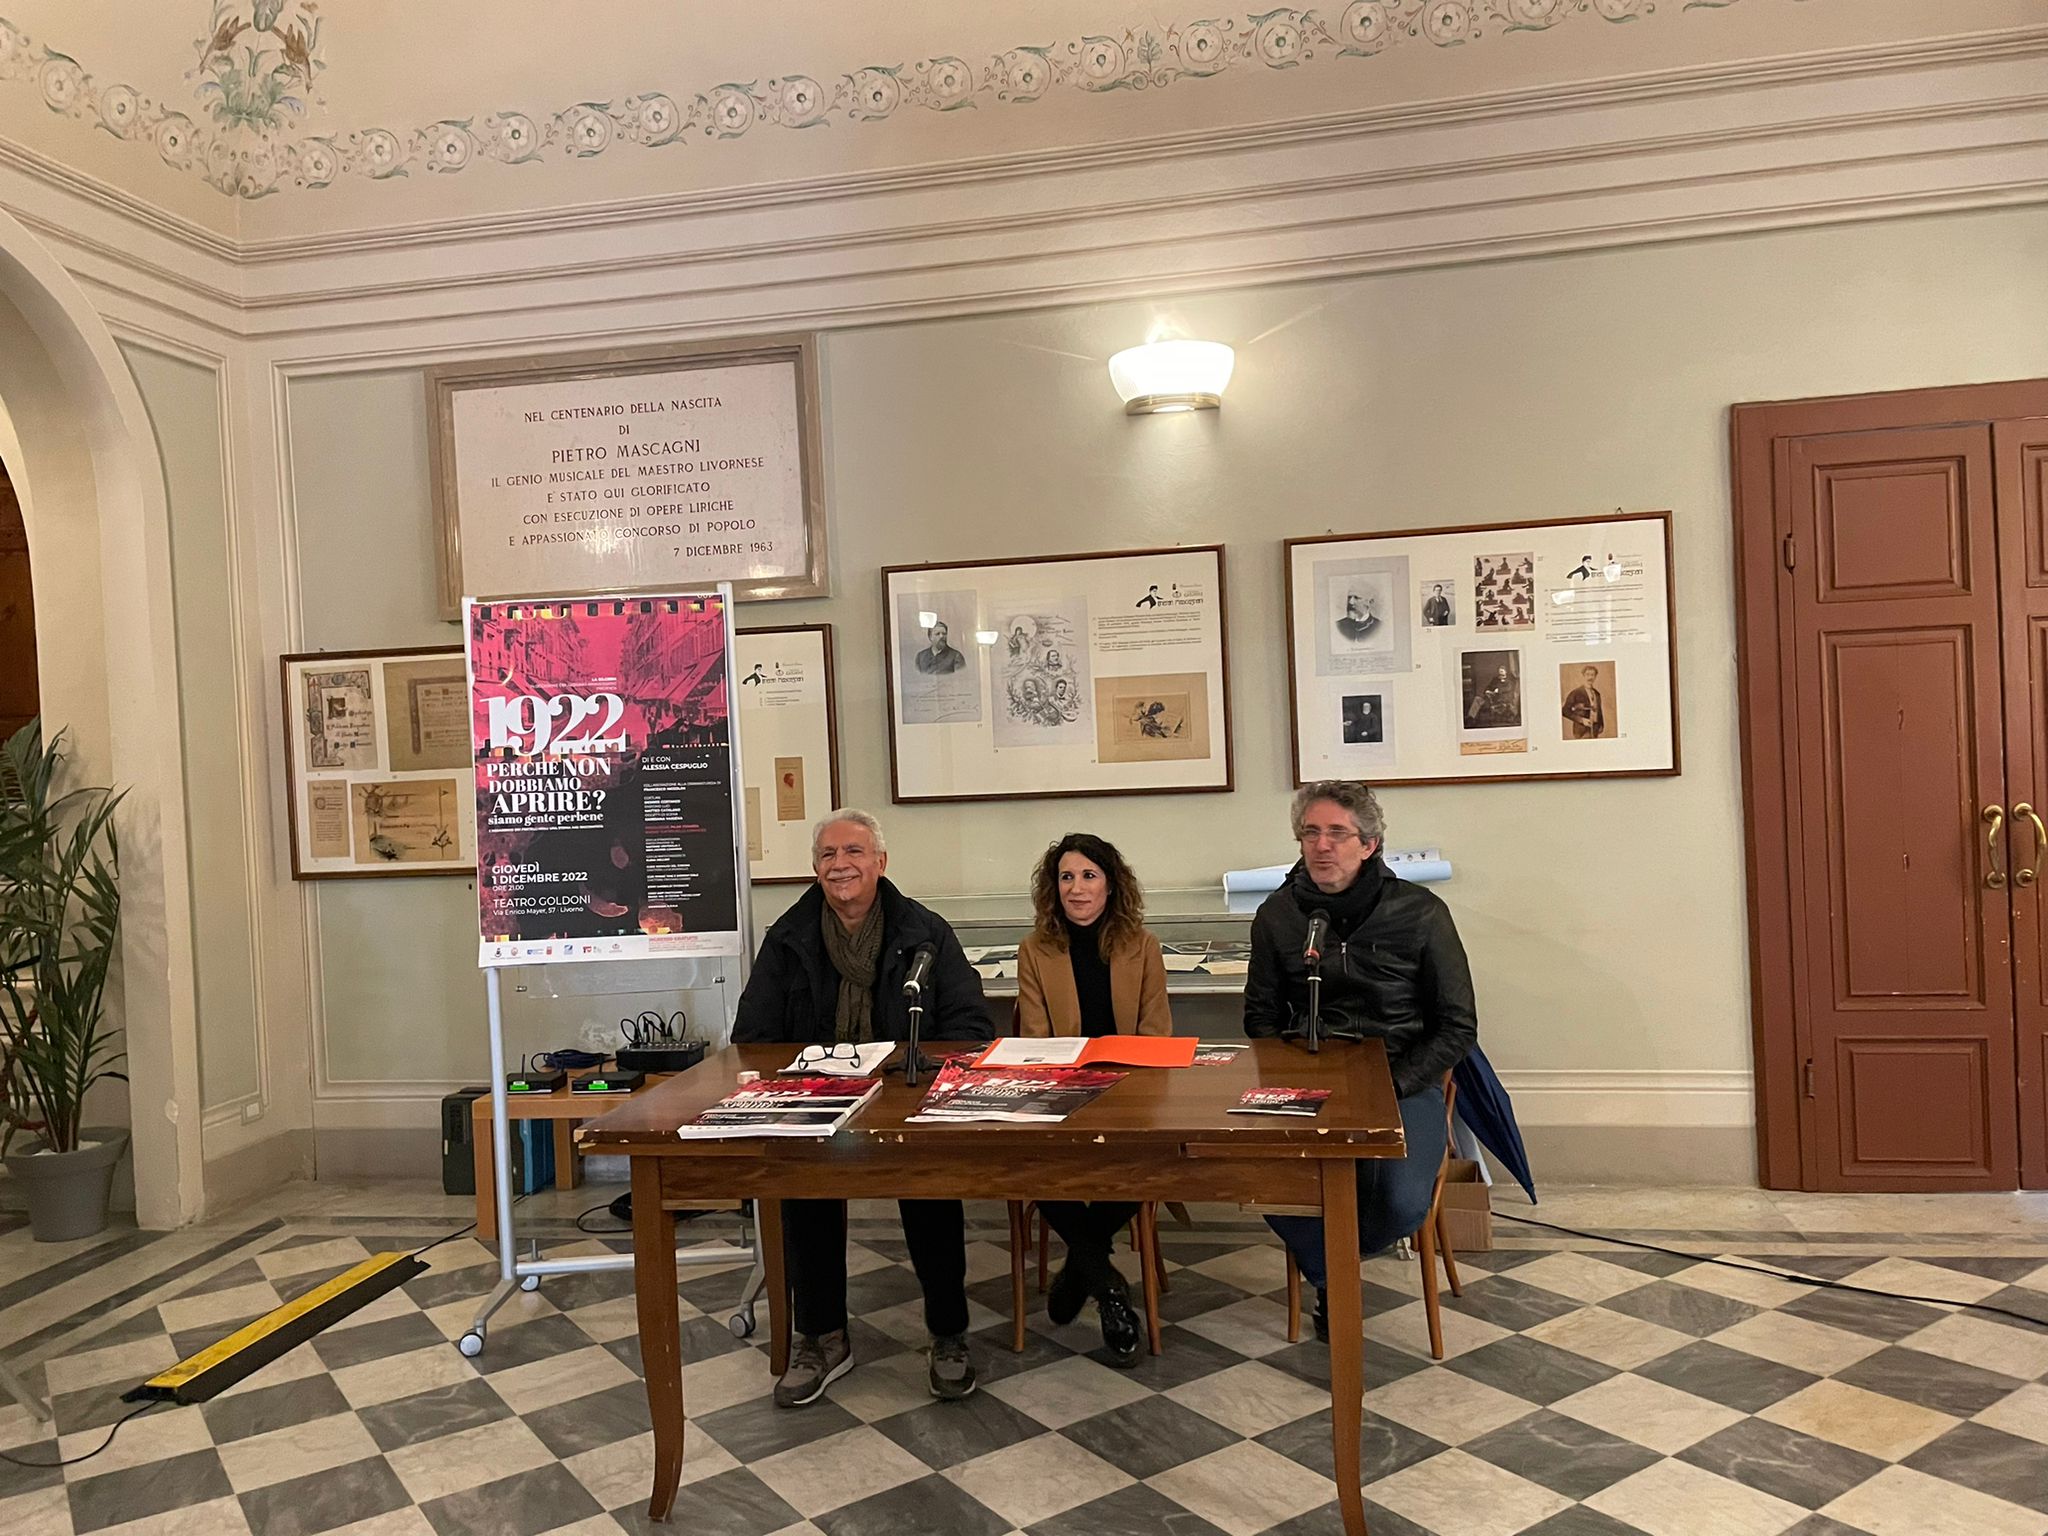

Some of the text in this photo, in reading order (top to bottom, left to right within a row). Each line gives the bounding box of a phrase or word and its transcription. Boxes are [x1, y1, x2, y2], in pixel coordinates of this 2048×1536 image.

[525, 398, 722, 422] NEL CENTENARIO DELLA NASCITA
[619, 425, 629, 435] DI
[552, 439, 700, 463] PIETRO MASCAGNI
[491, 457, 764, 487] IL GENIO MUSICALE DEL MAESTRO LIVORNESE
[560, 490, 597, 503] STATO
[604, 488, 624, 499] QUI
[631, 482, 710, 497] GLORIFICATO
[523, 500, 734, 525] CON ESECUZIONE DI OPERE LIRICHE
[509, 536, 515, 546] E
[615, 524, 681, 538] CONCORSO
[689, 522, 699, 533] DI
[707, 519, 755, 532] POPOLO
[673, 541, 773, 557] 7 DICEMBRE 1963
[480, 692, 626, 757] 1922
[563, 757, 611, 777] NON
[489, 777, 581, 793] DOBBIAMO
[491, 790, 606, 814] APRIRE?
[488, 812, 604, 826] siamo gente perbene
[492, 862, 539, 874] GIOVEDÌ
[492, 872, 588, 884] 1 DICEMBRE 2022
[493, 895, 591, 908] TEATRO GOLDONI
